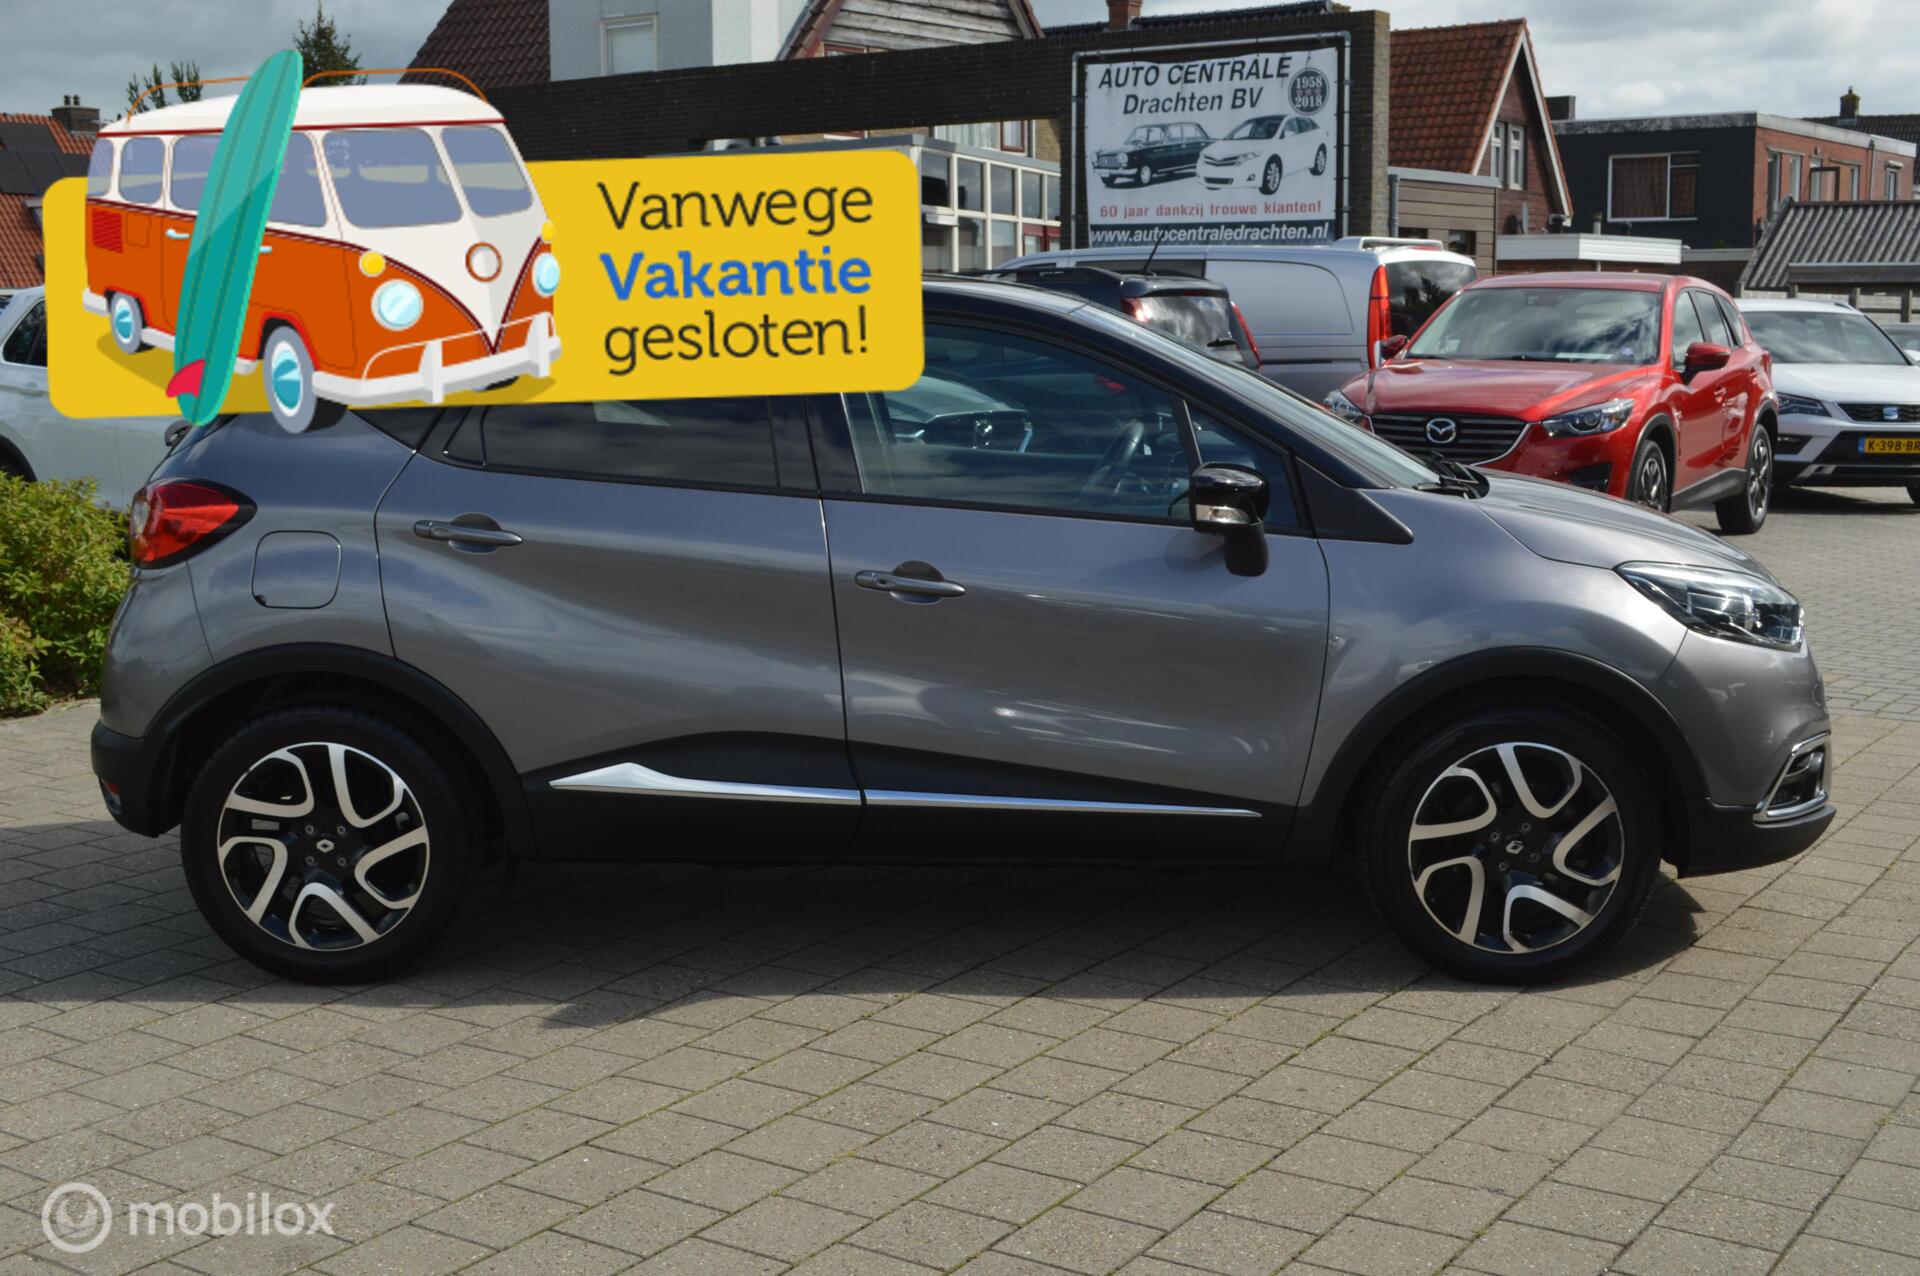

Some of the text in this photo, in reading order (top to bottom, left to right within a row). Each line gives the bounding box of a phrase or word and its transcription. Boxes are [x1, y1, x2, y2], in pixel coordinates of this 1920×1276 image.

[1098, 56, 1292, 89] AUTO CENTRALE
[1295, 76, 1323, 89] 1958
[1123, 87, 1264, 115] Drachten BV
[1295, 95, 1323, 108] 2018
[1100, 200, 1322, 219] 60 jaar dankzij trouwe klanten!
[1090, 222, 1329, 244] www.autocentraledrachten.nl
